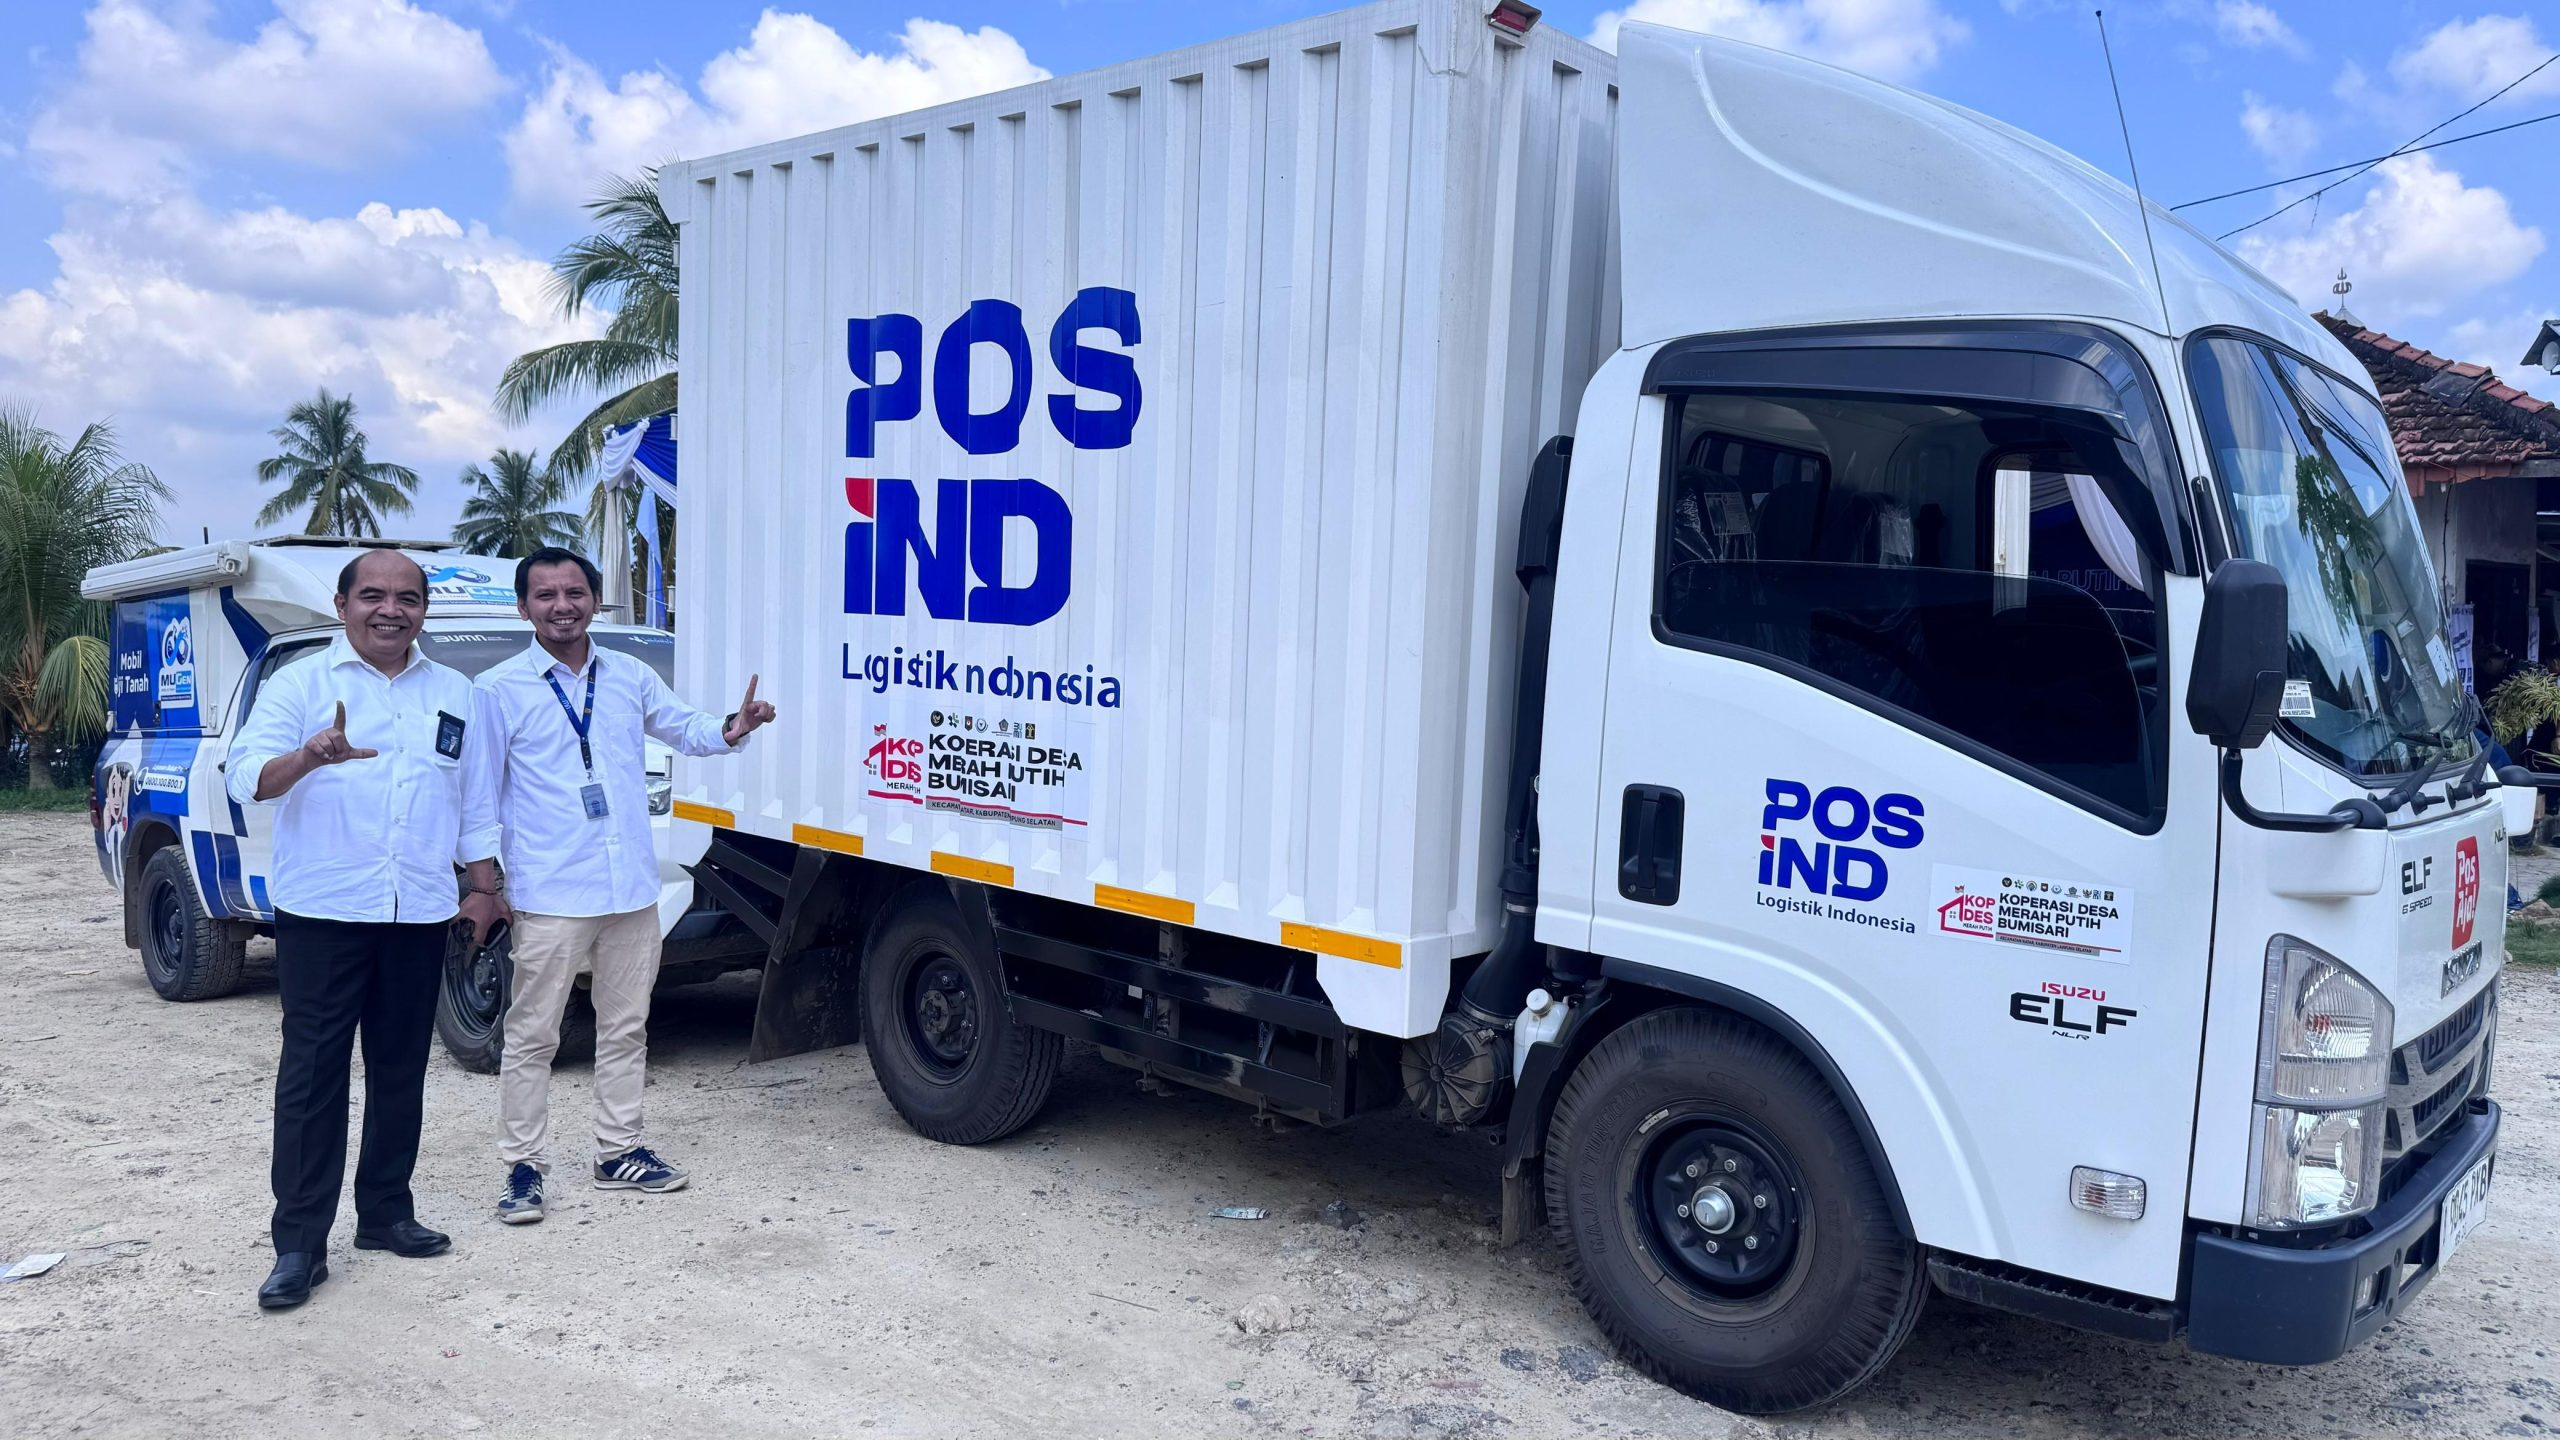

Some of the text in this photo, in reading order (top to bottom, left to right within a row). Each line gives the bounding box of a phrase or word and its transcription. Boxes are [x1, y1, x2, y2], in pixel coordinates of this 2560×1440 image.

[846, 286, 1142, 458] POS
[120, 650, 142, 671] Mobil
[125, 673, 149, 693] Tanah
[1762, 778, 1925, 849] POS
[2402, 856, 2432, 896] ELF
[2457, 850, 2476, 888] Pos
[1756, 891, 1916, 934] Logistik Indonesia
[1964, 894, 1995, 909] KOP
[1999, 892, 2073, 913] KOPERASI
[2078, 903, 2119, 919] DESA
[2409, 896, 2432, 912] SPEED
[2456, 884, 2477, 933] Aja!
[1963, 908, 1993, 924] DES
[1997, 917, 2069, 938] BUMISARI
[1998, 905, 2101, 930] MERAH PUTIH
[2041, 981, 2106, 1002] ISUZU
[2009, 992, 2138, 1035] ELF
[2051, 1029, 2090, 1041] NLR
